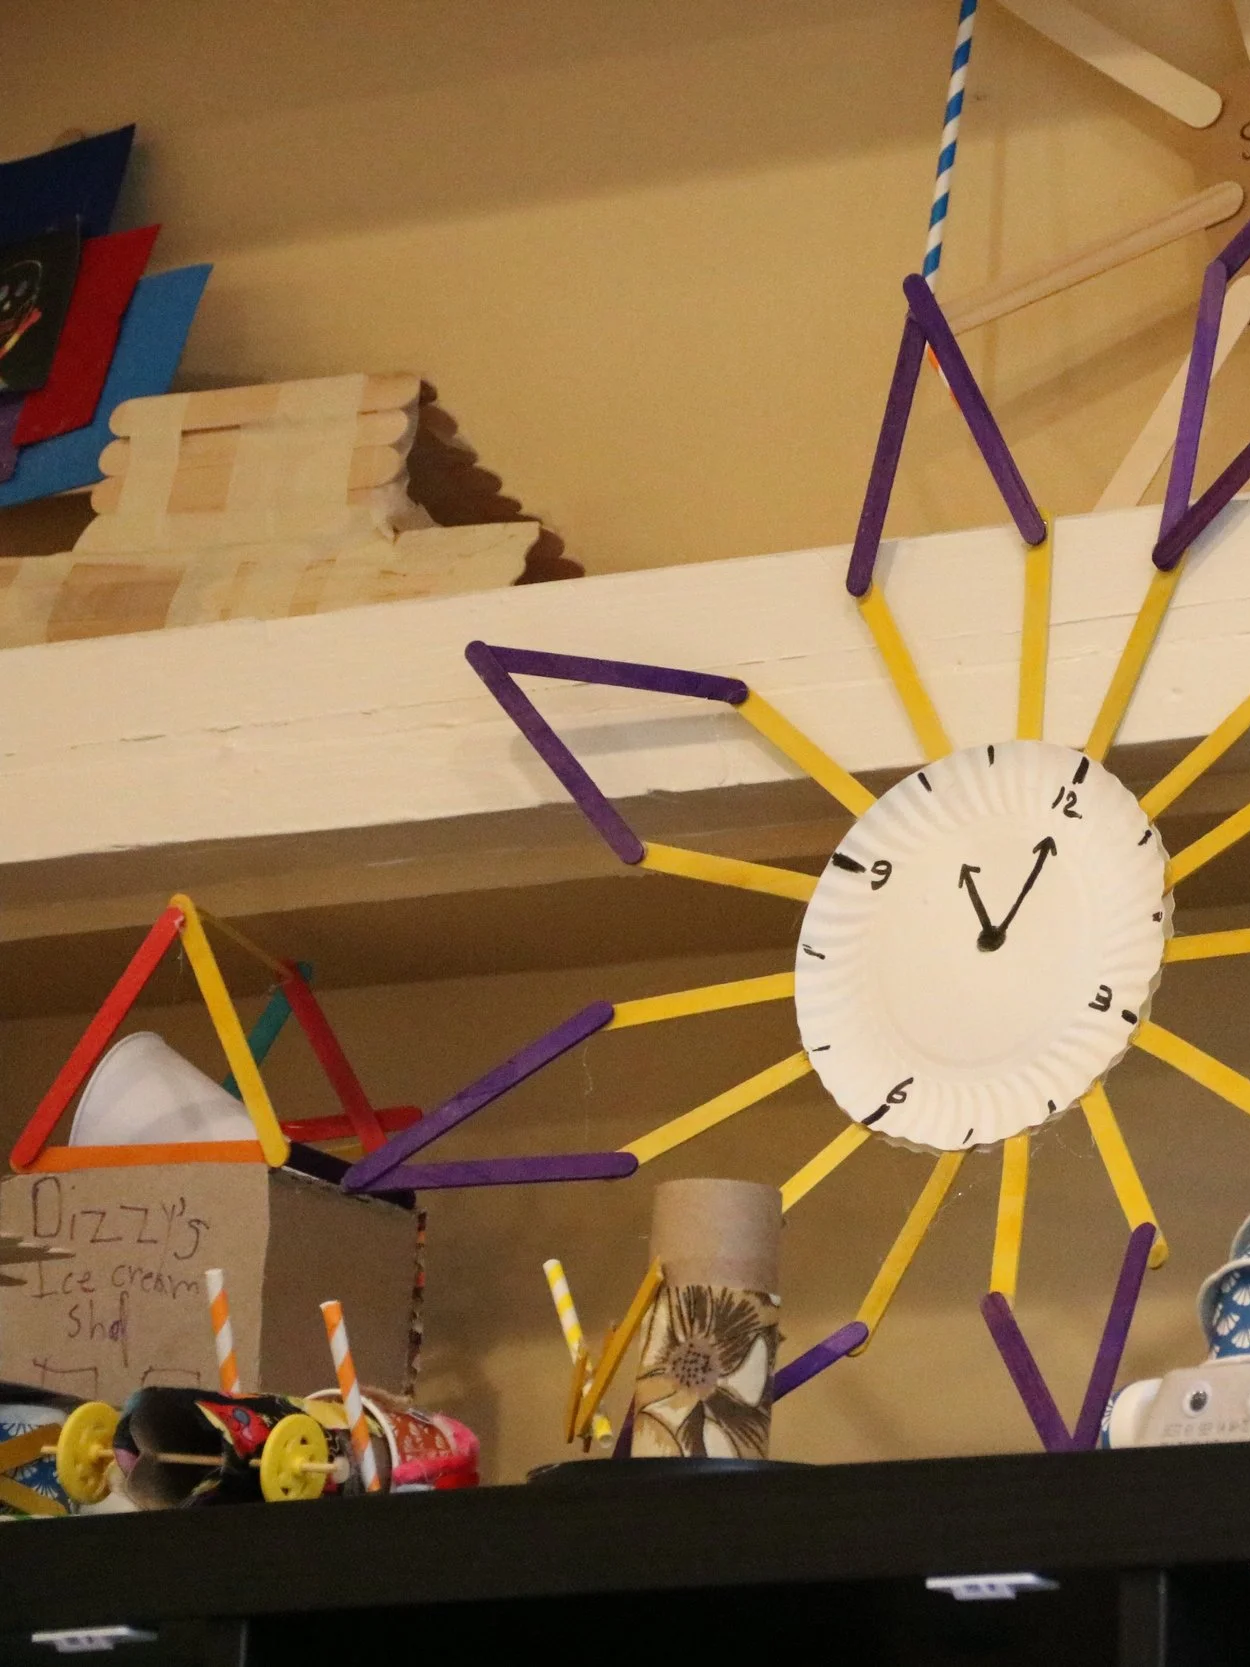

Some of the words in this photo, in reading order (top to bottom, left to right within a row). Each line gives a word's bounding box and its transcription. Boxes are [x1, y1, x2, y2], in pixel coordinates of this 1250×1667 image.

[1052, 786, 1082, 819] 12
[870, 859, 892, 890] 9
[1088, 984, 1113, 1012] 3
[886, 1076, 914, 1104] 6
[32, 1261, 96, 1298] Ice
